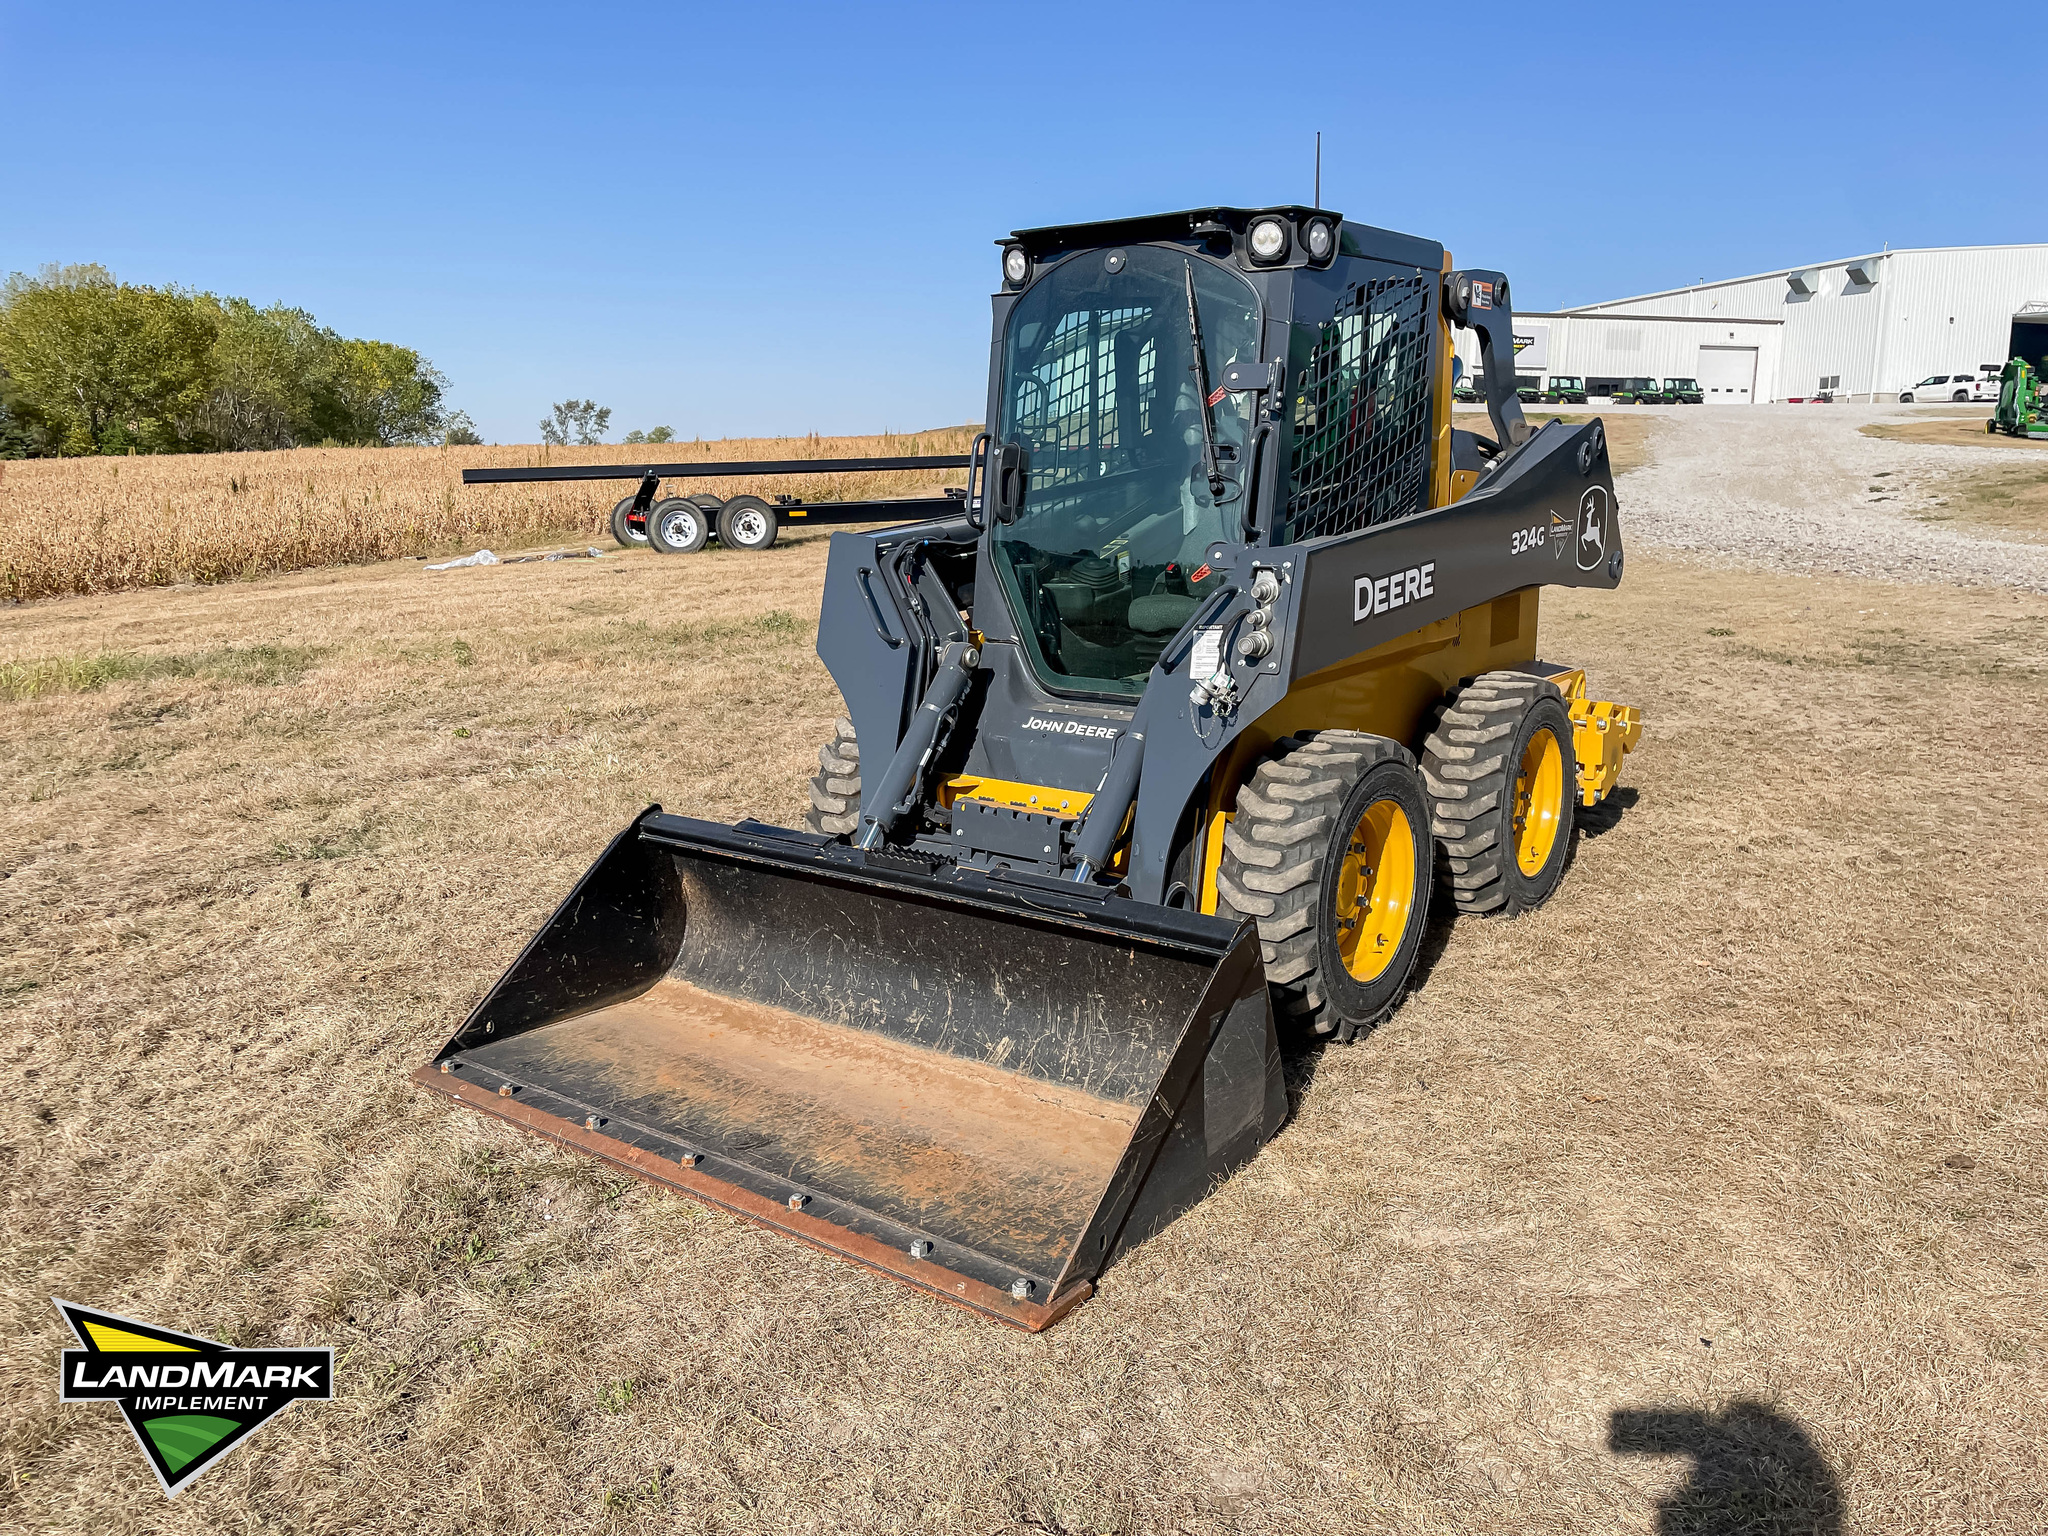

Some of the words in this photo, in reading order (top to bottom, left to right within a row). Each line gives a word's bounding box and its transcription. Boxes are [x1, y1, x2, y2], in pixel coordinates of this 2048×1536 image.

[1511, 526, 1545, 555] 324G
[1354, 562, 1435, 622] DEERE
[1022, 716, 1063, 732] JOHN
[1063, 721, 1118, 739] DEERE
